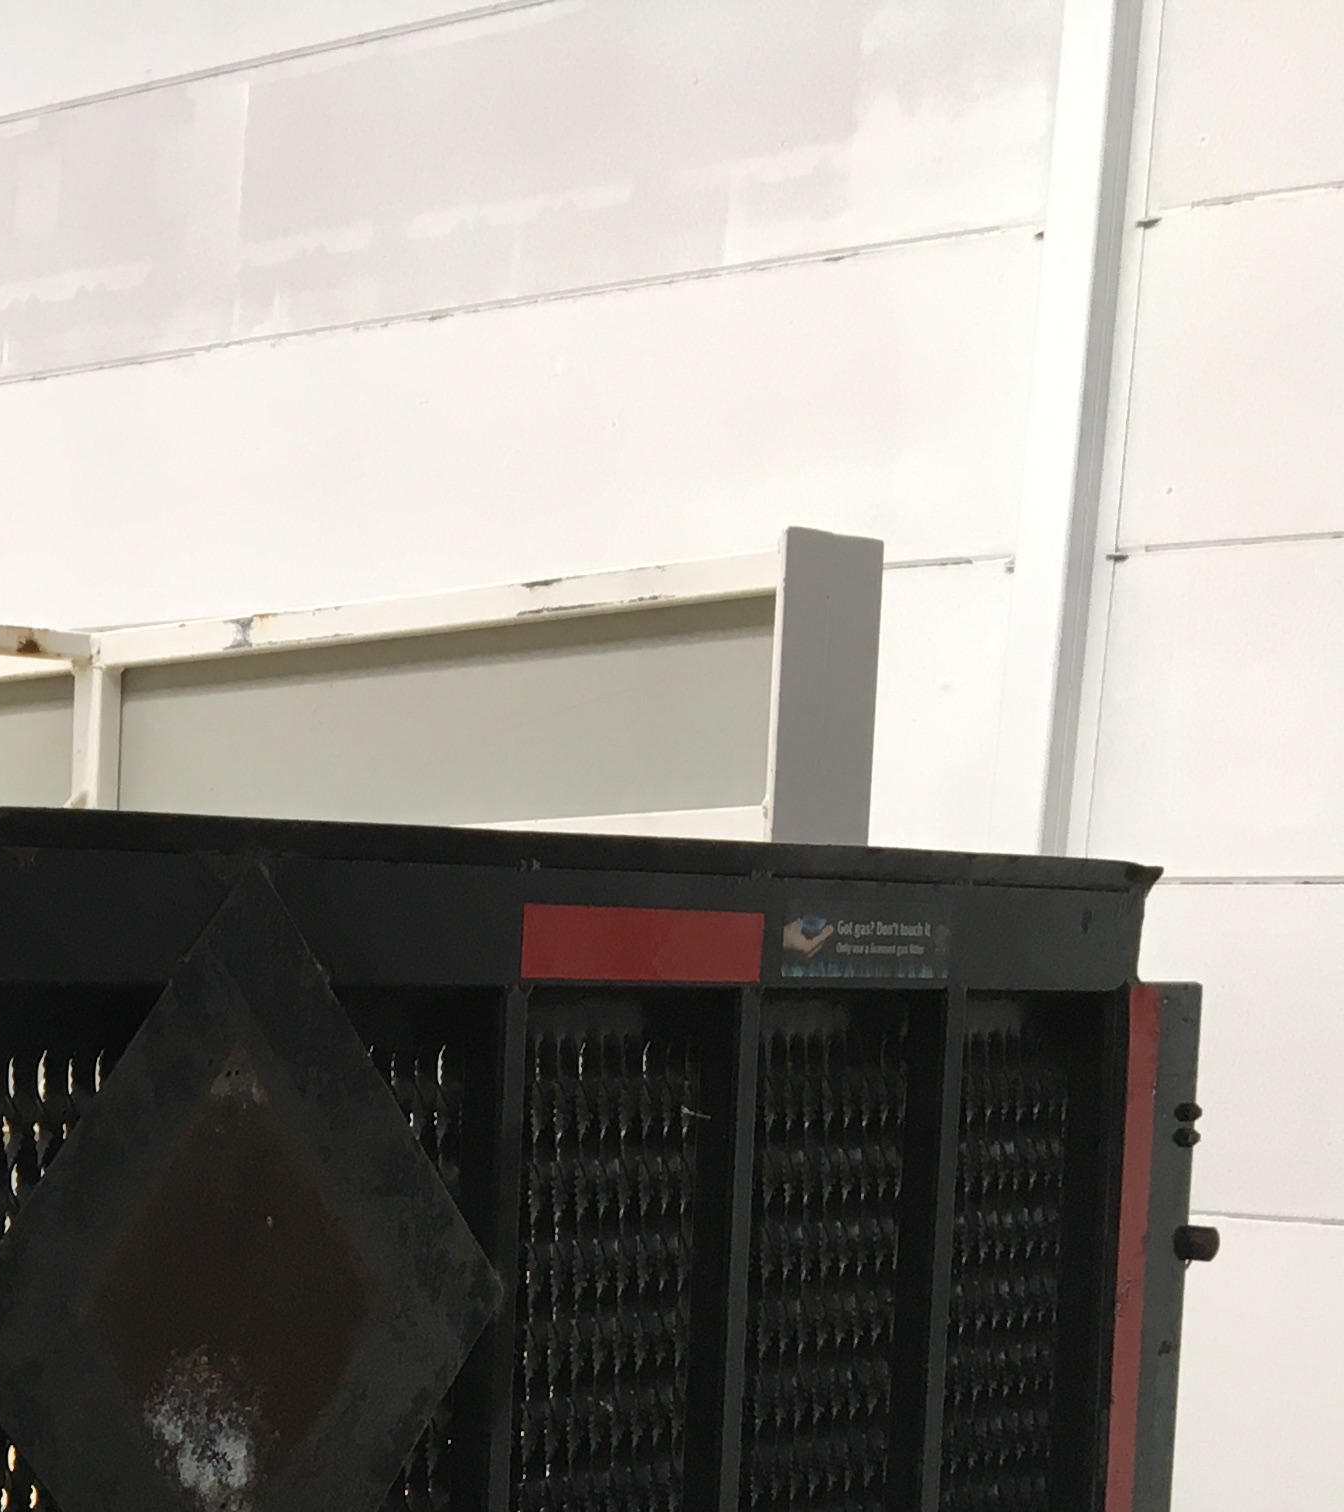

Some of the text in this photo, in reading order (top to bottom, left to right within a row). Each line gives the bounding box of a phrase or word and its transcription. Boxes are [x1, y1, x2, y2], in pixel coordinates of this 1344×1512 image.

[837, 920, 853, 935] Got
[854, 920, 875, 938] gas?
[900, 922, 923, 937] touch
